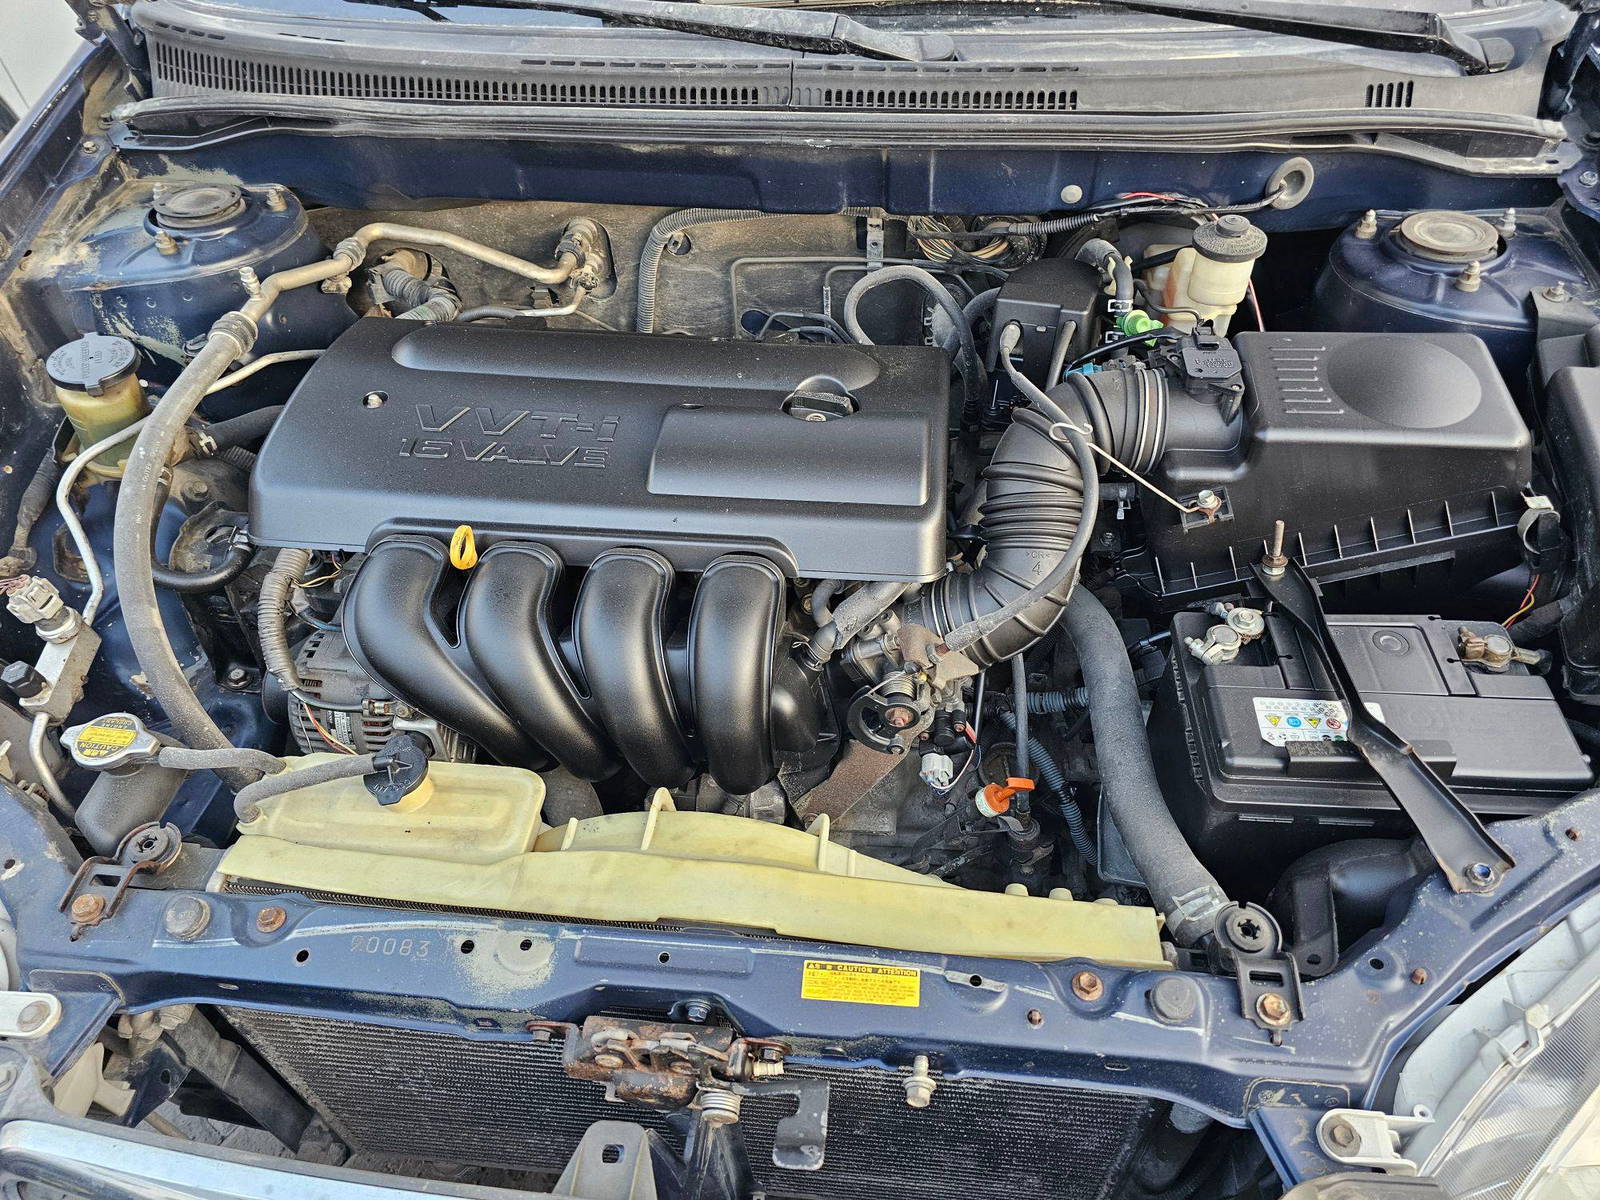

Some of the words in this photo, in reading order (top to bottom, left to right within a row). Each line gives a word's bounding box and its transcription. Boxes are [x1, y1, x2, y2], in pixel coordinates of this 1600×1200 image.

[399, 436, 453, 459] 16
[460, 439, 609, 468] VALVE
[1031, 560, 1043, 576] 4
[79, 742, 118, 751] CAUTION
[837, 964, 873, 974] CAUTION
[877, 967, 917, 977] ATTENTION
